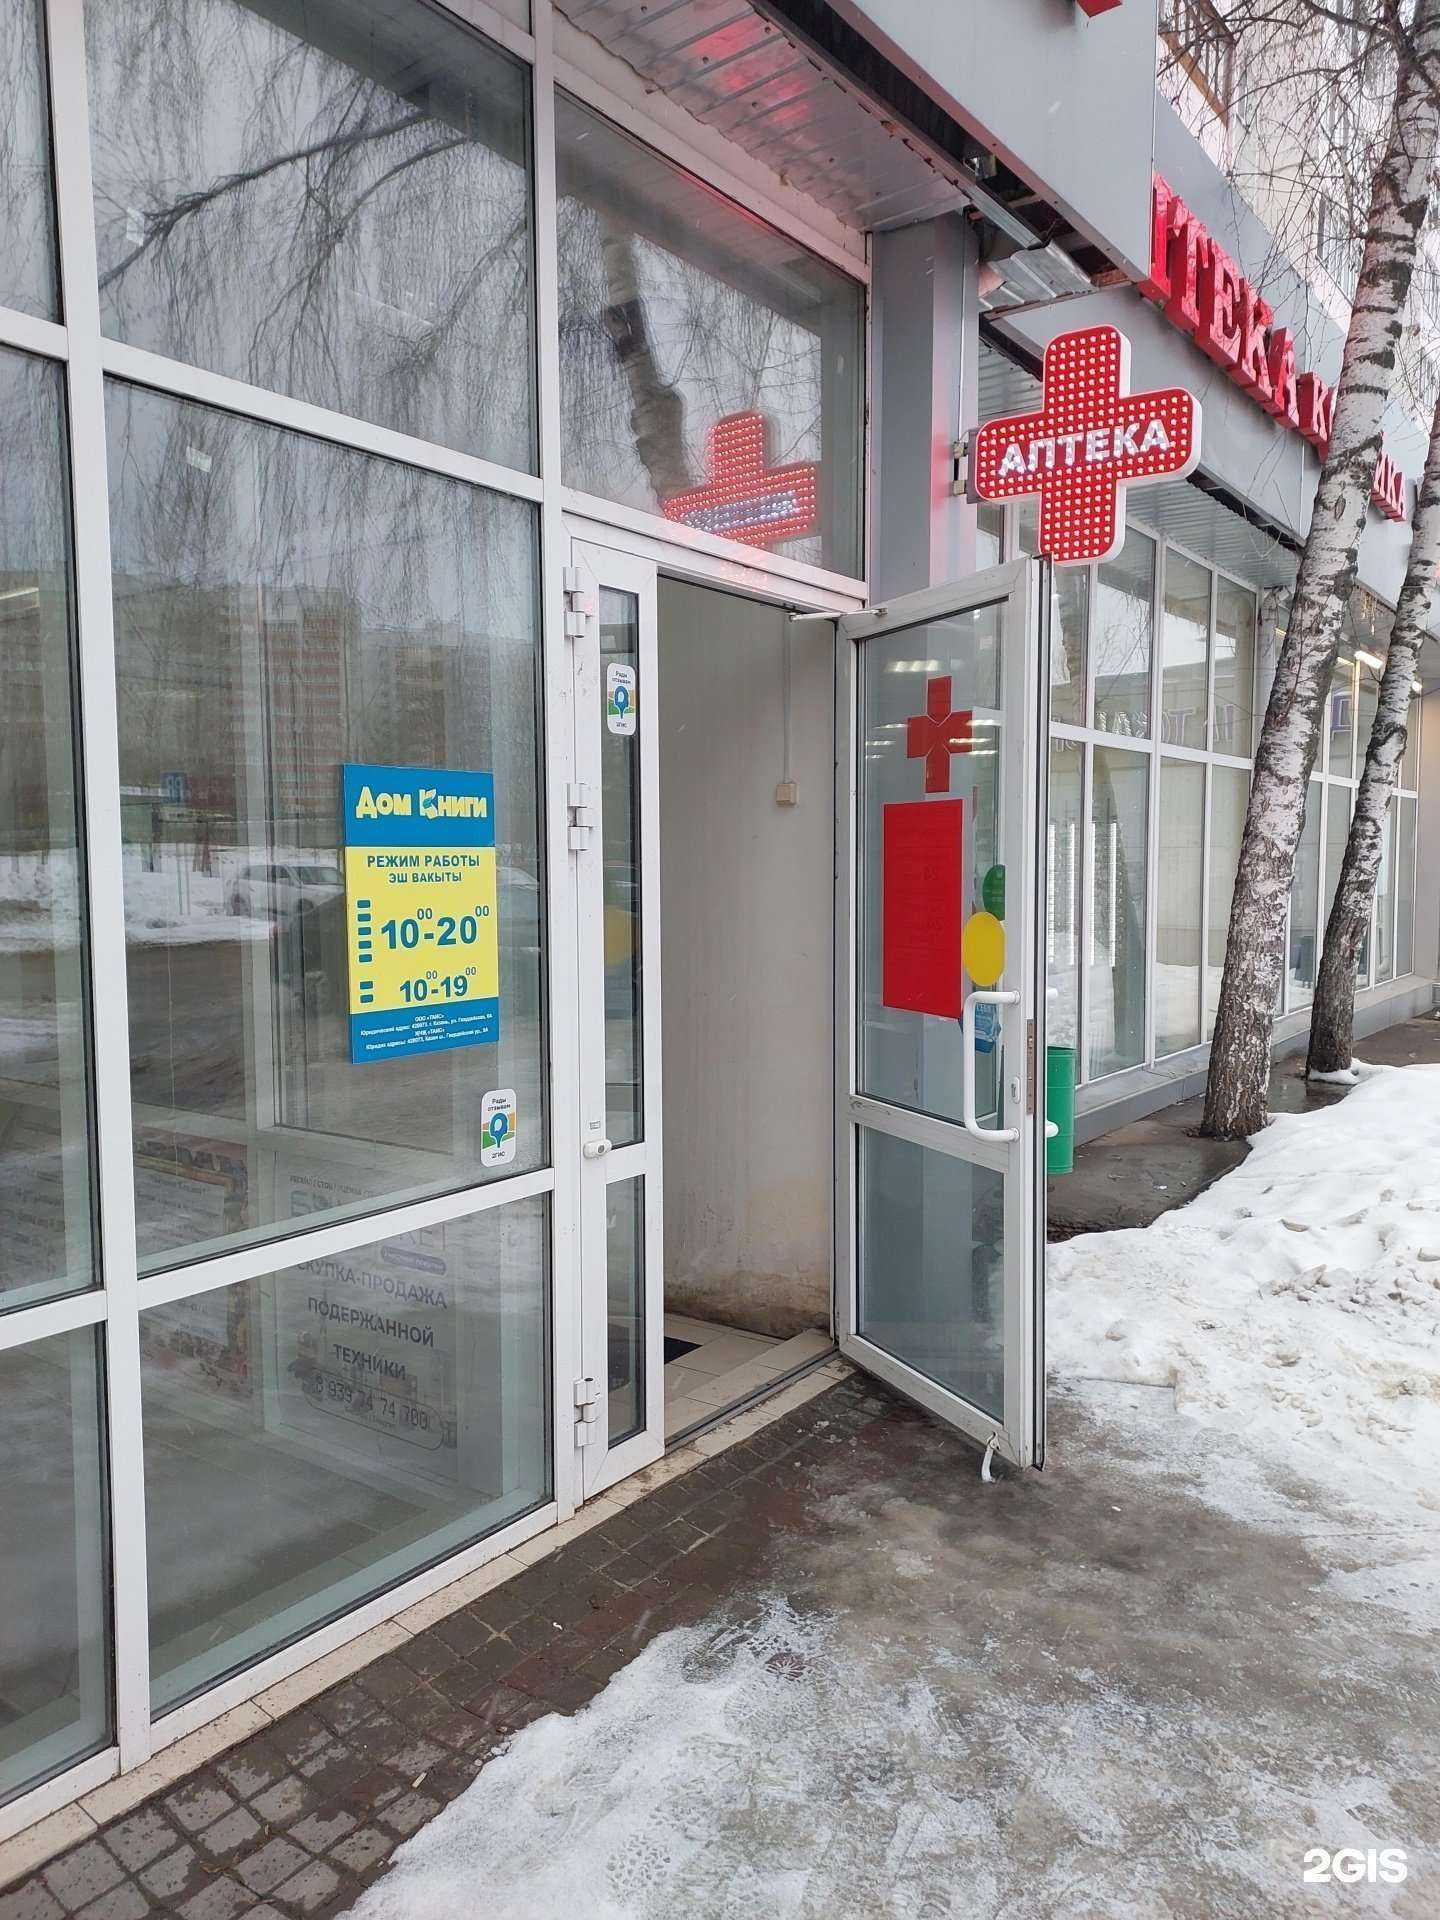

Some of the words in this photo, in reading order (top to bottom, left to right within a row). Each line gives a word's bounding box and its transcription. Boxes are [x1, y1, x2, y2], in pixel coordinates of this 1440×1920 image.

[999, 418, 1170, 476] АПТЕКА
[355, 786, 412, 819] Дом
[367, 855, 419, 868] РЕЖИМ
[424, 855, 480, 867] РАБОТЫ
[388, 872, 408, 883] ЭШ
[412, 871, 462, 882] ВАКЫТЫ
[308, 1296, 434, 1348] ПОДЕРЖАННОЙ
[333, 1343, 406, 1381] ТЕХНИКИ
[381, 1396, 395, 1420] 74
